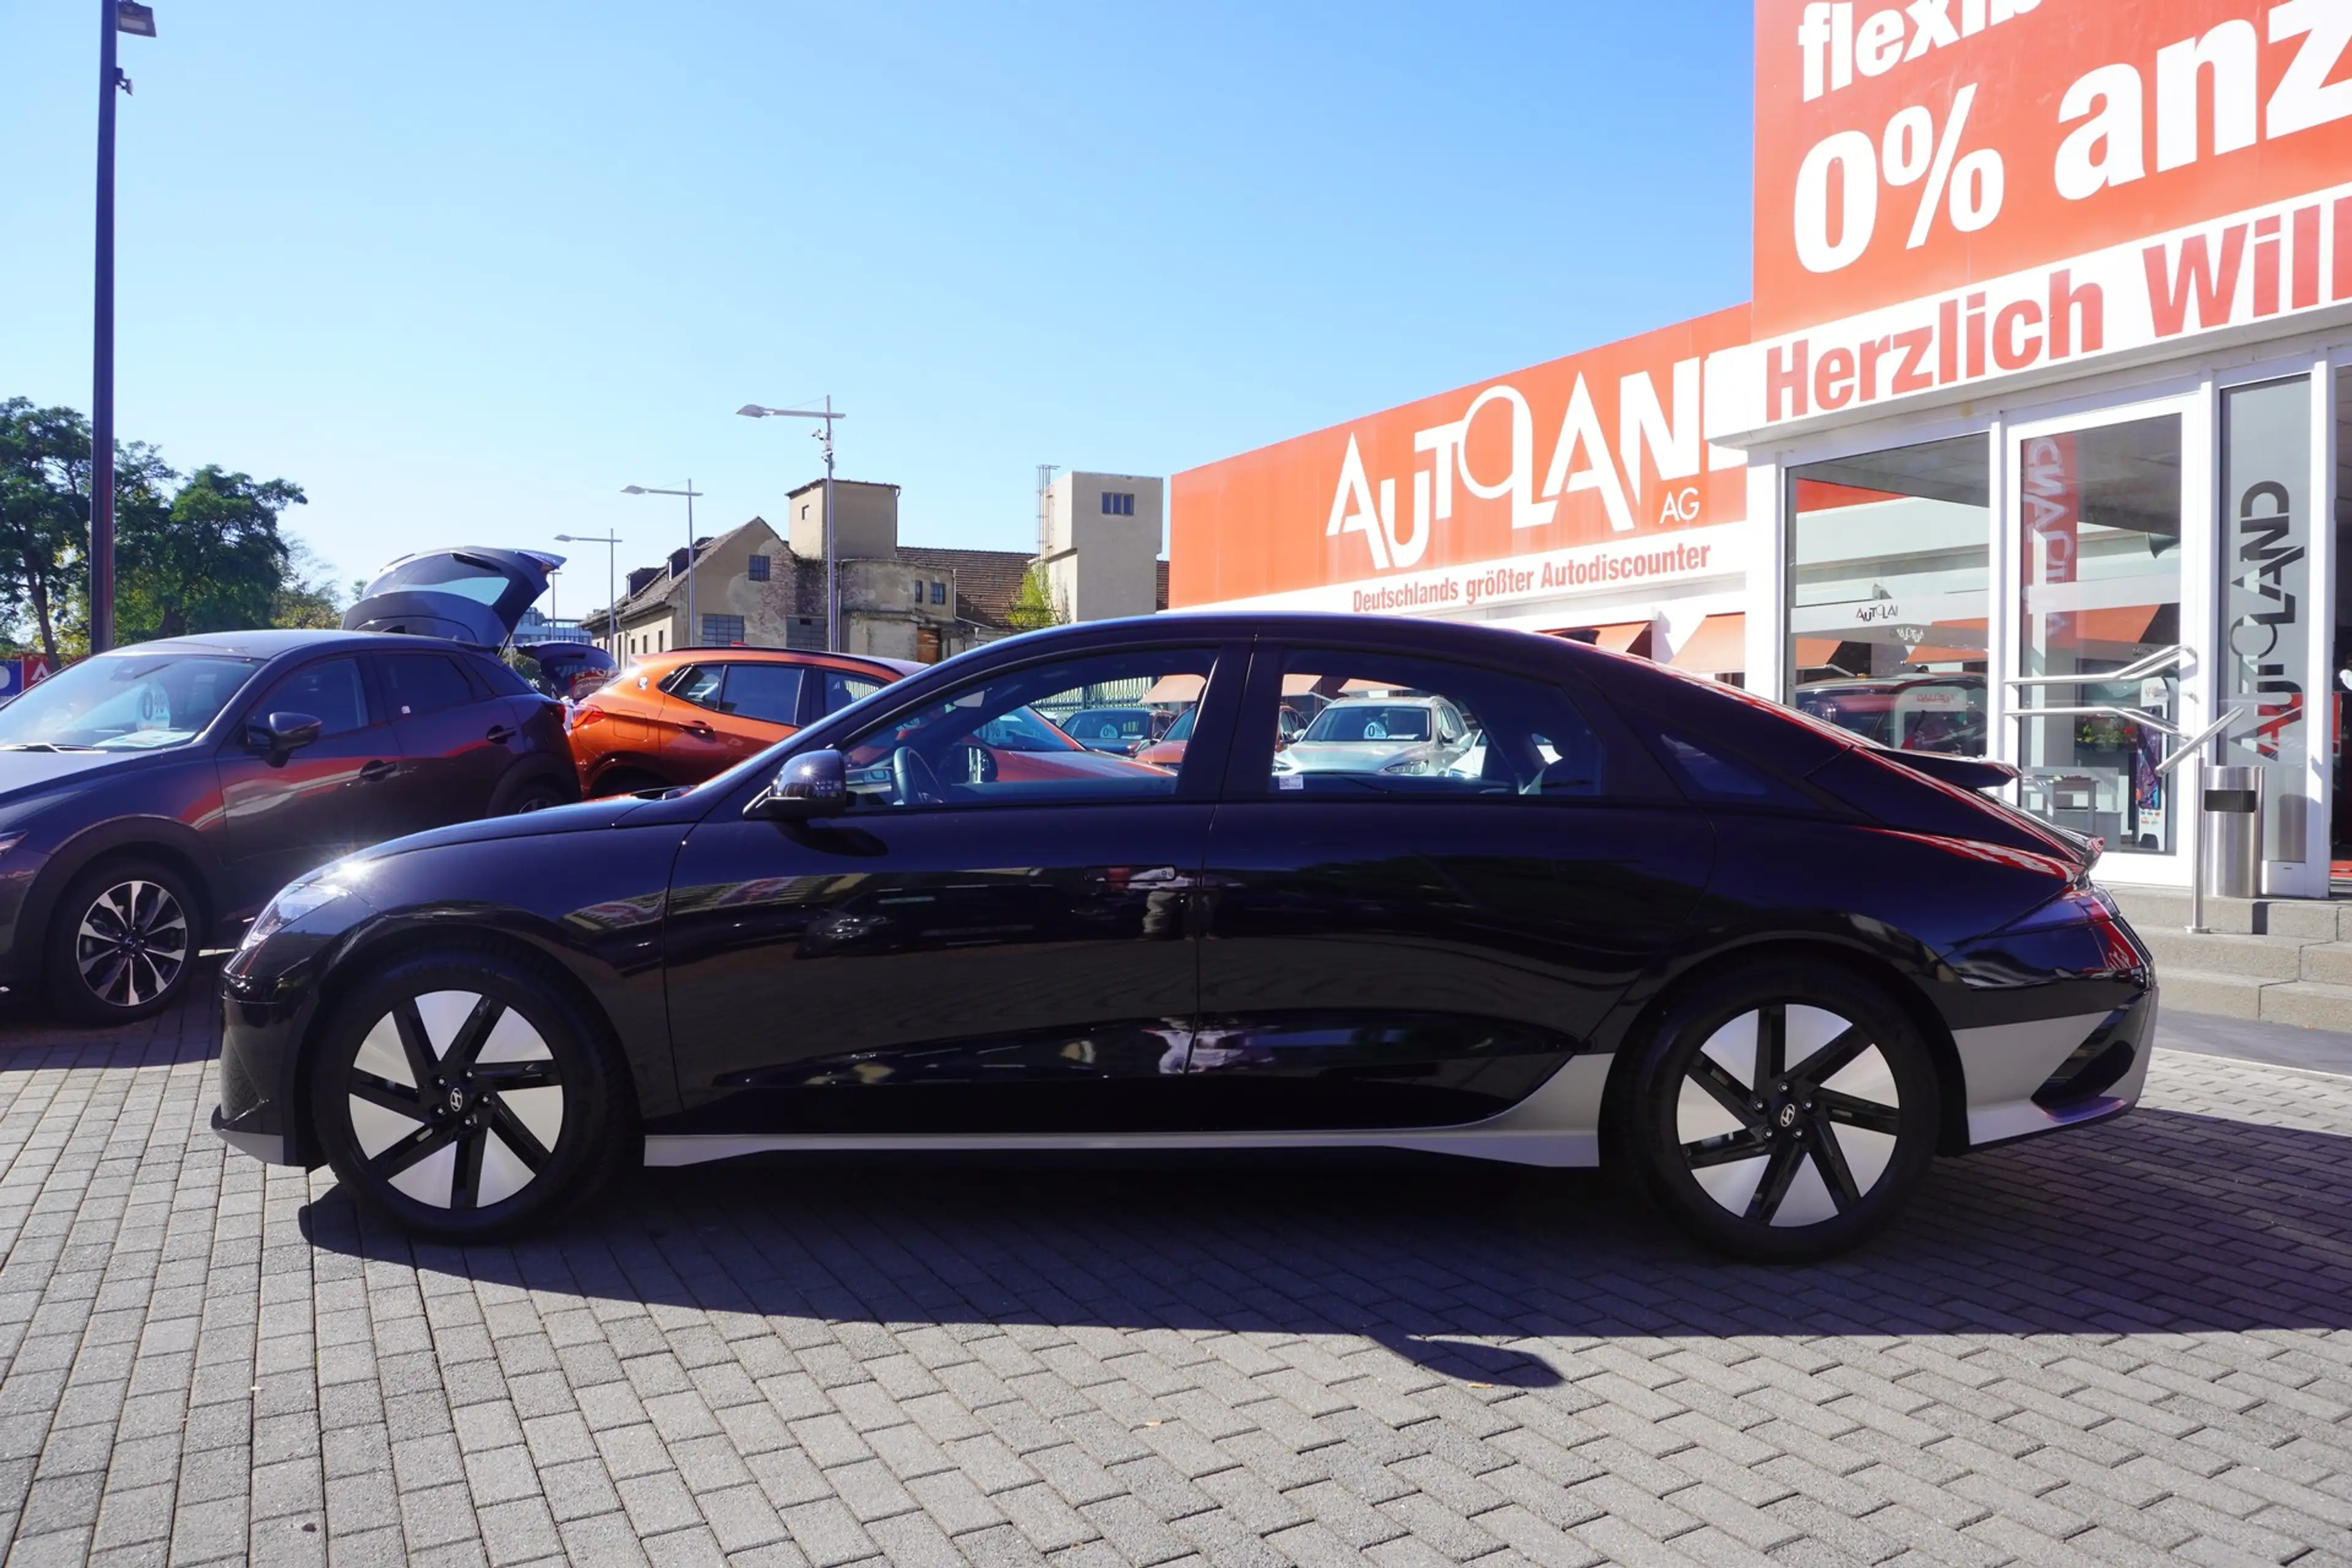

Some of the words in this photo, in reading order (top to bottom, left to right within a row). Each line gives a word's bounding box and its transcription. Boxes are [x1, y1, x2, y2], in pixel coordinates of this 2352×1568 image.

[1794, 81, 2005, 273] 0%
[1766, 270, 2103, 422] Herzlich
[1325, 356, 1747, 570] AUTOLAN
[1659, 487, 1700, 524] AG
[1353, 576, 1459, 612] Deutschlands
[1466, 569, 1534, 606] größter
[1540, 543, 1711, 589] Autodiscounter
[2228, 480, 2305, 762] AUTOLAND
